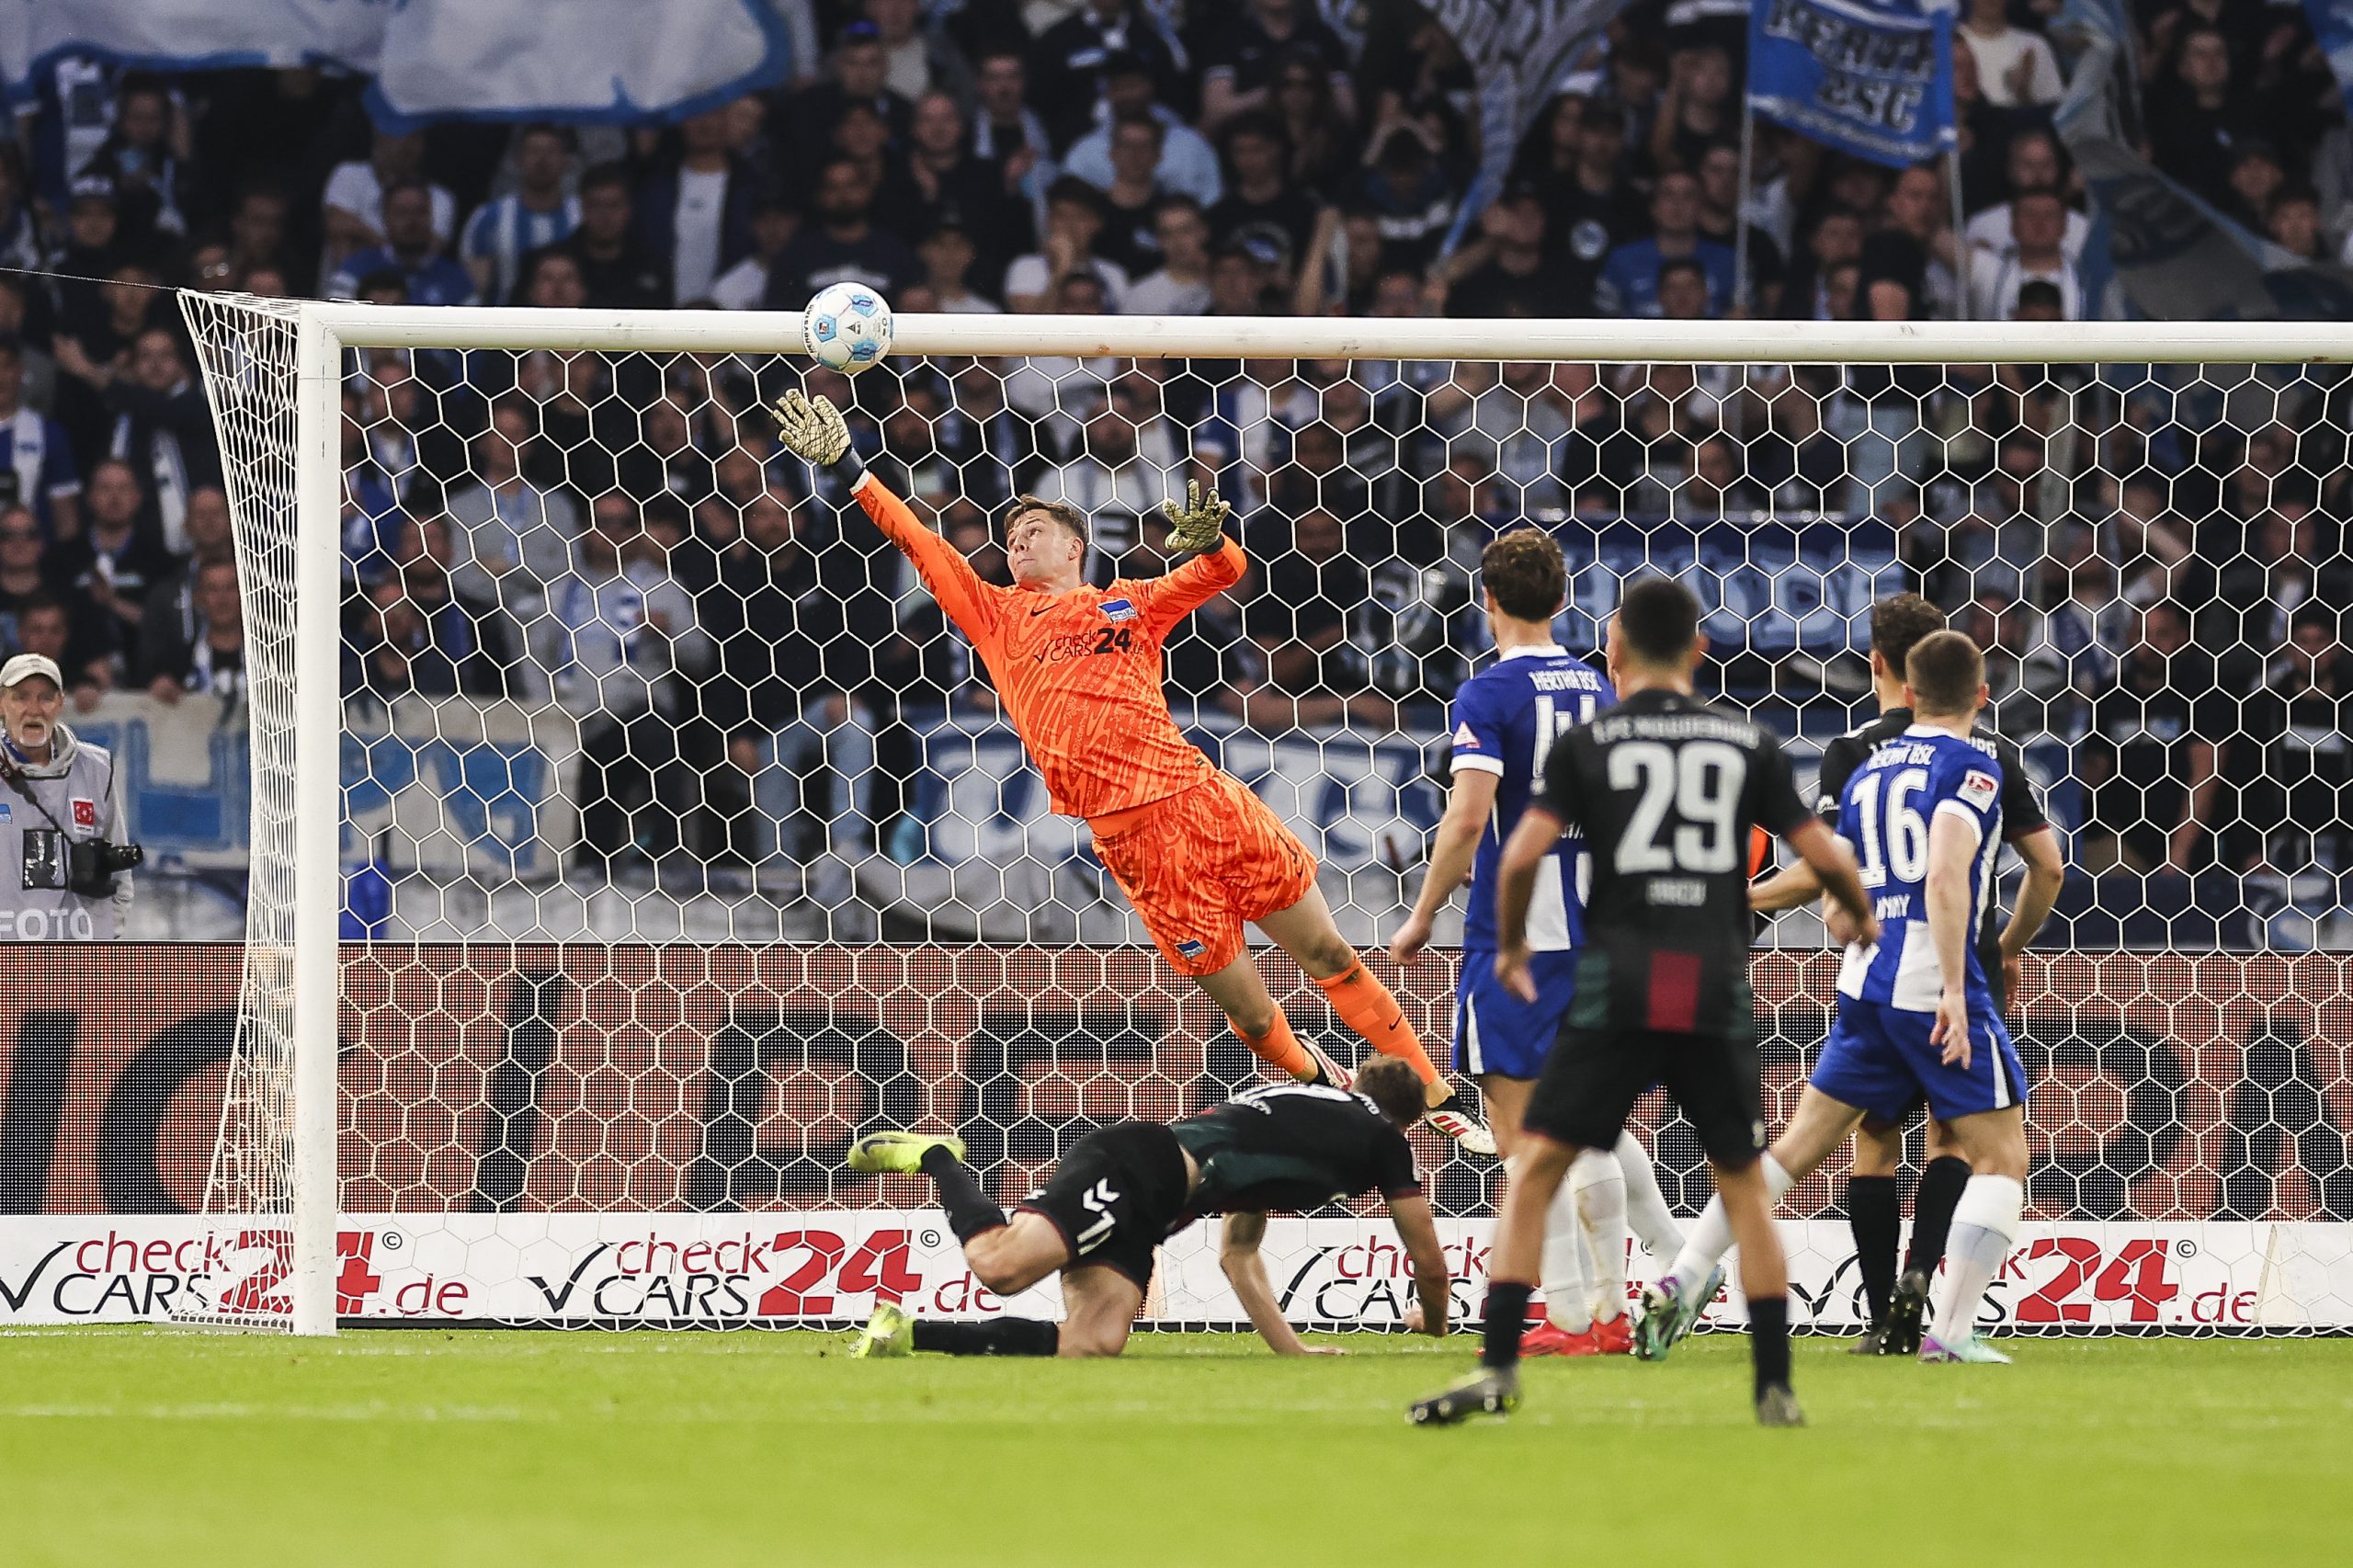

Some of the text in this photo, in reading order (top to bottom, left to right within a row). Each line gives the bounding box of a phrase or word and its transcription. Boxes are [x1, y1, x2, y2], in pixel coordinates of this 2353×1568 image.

[1051, 645, 1093, 661] CARS
[1056, 630, 1097, 647] check
[1094, 628, 1131, 654] 24
[1608, 740, 1746, 875] 29
[1850, 768, 1928, 890] 16
[76, 1231, 232, 1274] check
[616, 1232, 772, 1274] check
[757, 1230, 922, 1316] 24
[53, 1274, 211, 1315] CARS
[380, 1273, 469, 1315] .de
[593, 1275, 750, 1316] CARS
[2016, 1238, 2179, 1323] 24
[2175, 1282, 2257, 1323] .de
